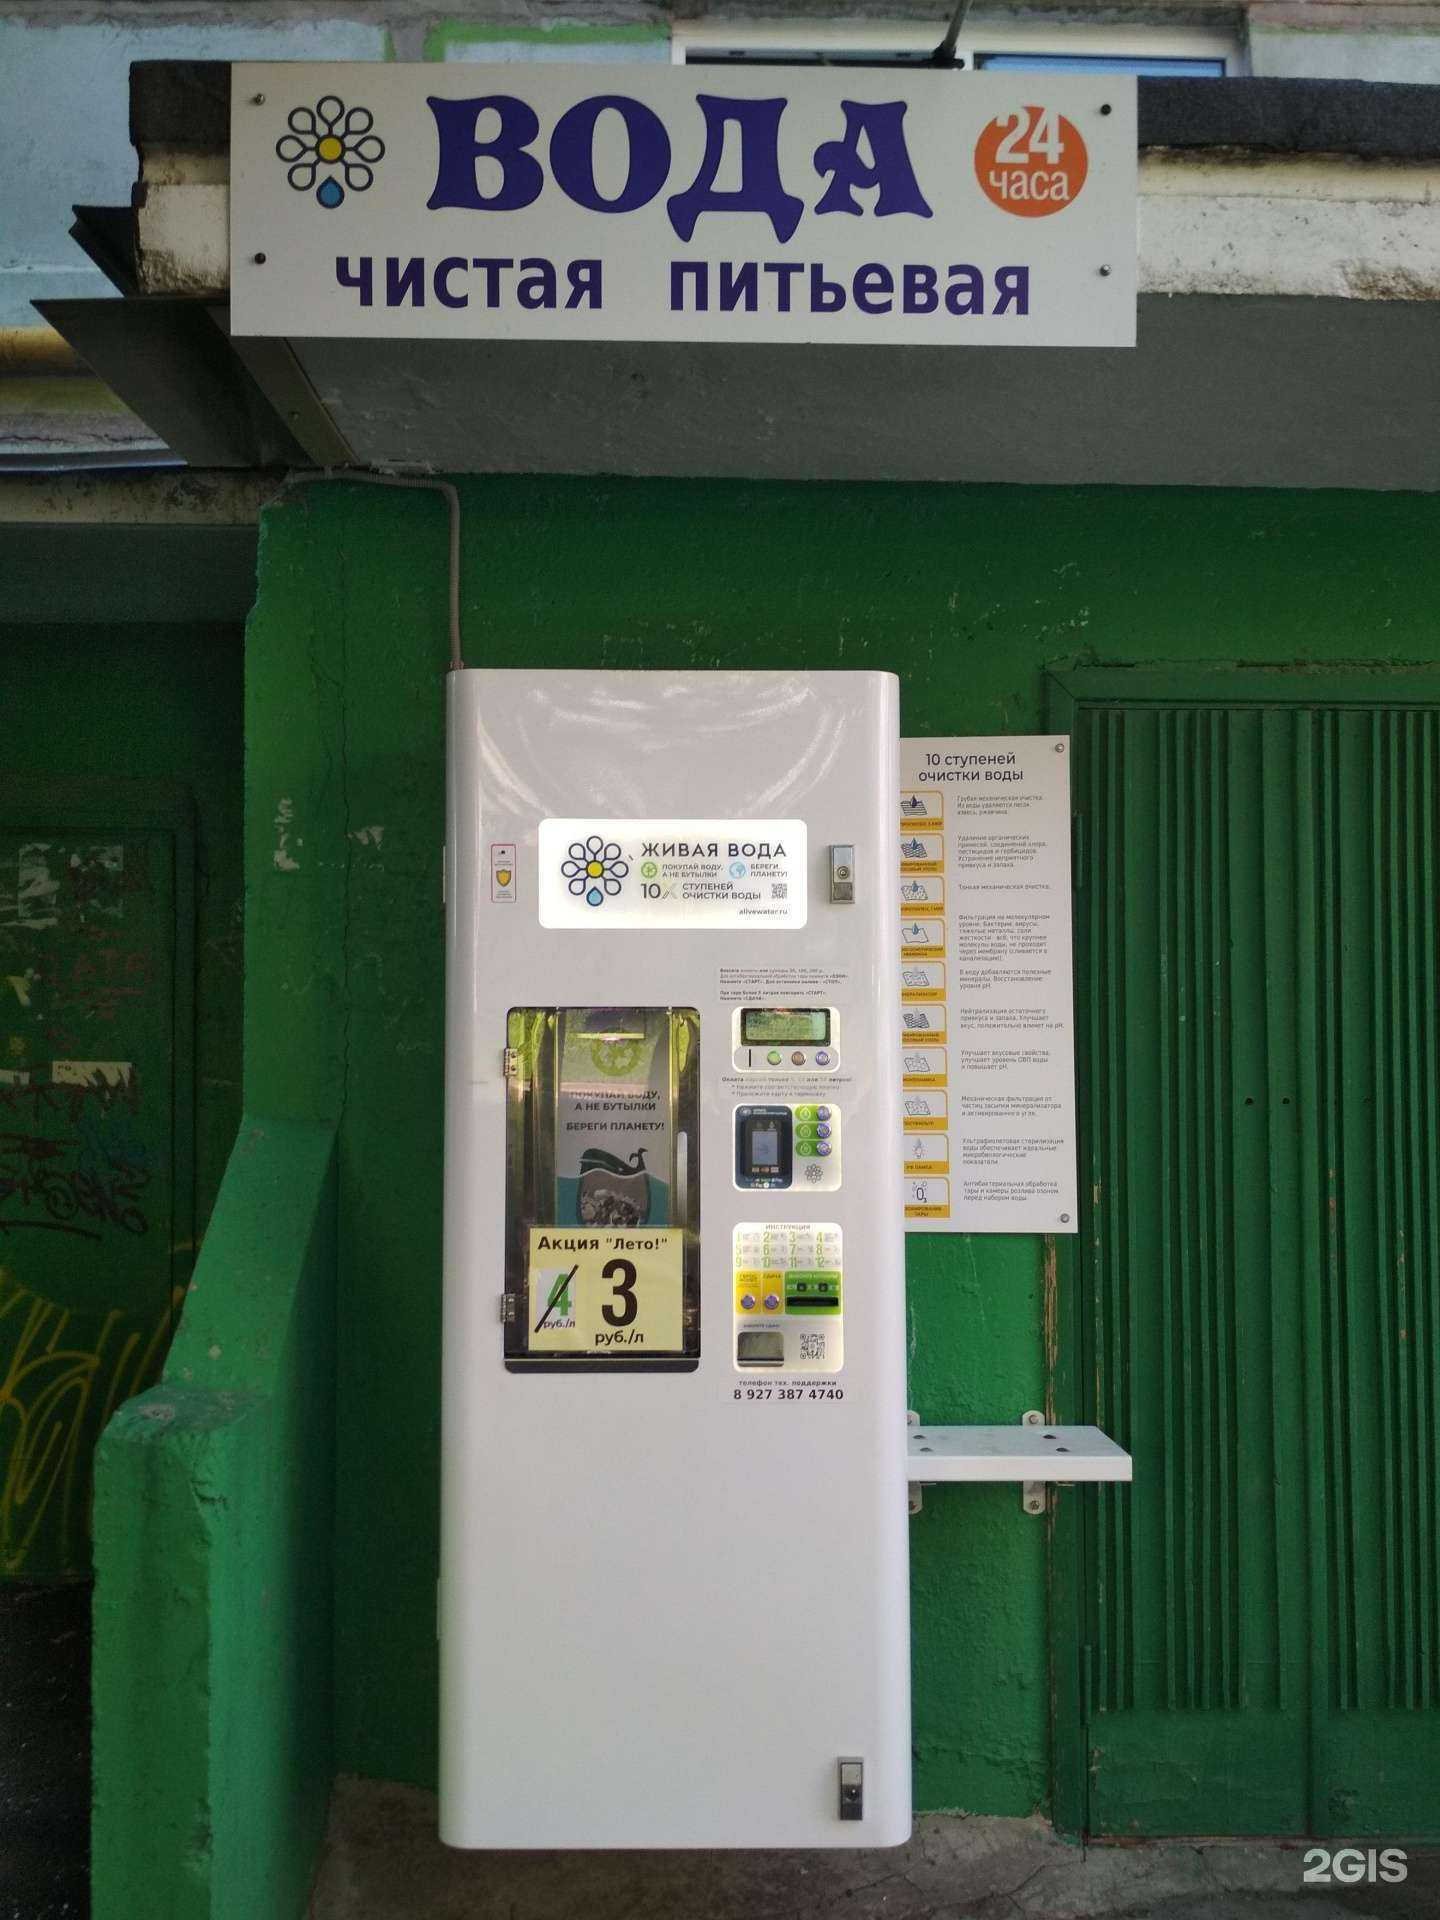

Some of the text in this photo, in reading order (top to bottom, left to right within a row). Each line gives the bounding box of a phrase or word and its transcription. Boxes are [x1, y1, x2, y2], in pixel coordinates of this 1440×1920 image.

[995, 106, 1060, 164] 24
[426, 94, 933, 243] ВОДА
[991, 166, 1070, 203] часа
[335, 257, 1030, 316] чистая питьевая
[926, 752, 1016, 768] 10 ступеней
[918, 770, 1024, 782] очистки воды
[641, 843, 786, 859] ЖИВАЯ ВОДА
[683, 881, 734, 891] СТУПЕНЕЙ
[683, 892, 761, 901] ОЧИСТКИ ВОДЫ
[575, 1102, 656, 1111] А НЕ БУТЫЛКИ
[566, 1122, 665, 1131] БЕРЕГИ ПЛАНЕТУ!
[538, 1236, 668, 1252] Акция "Лето!"
[548, 1274, 572, 1316] 4
[601, 1259, 638, 1327] 3
[543, 1319, 575, 1329] руб./л
[595, 1329, 644, 1346] руб./л
[734, 1389, 844, 1400] 8 927 387 4740
